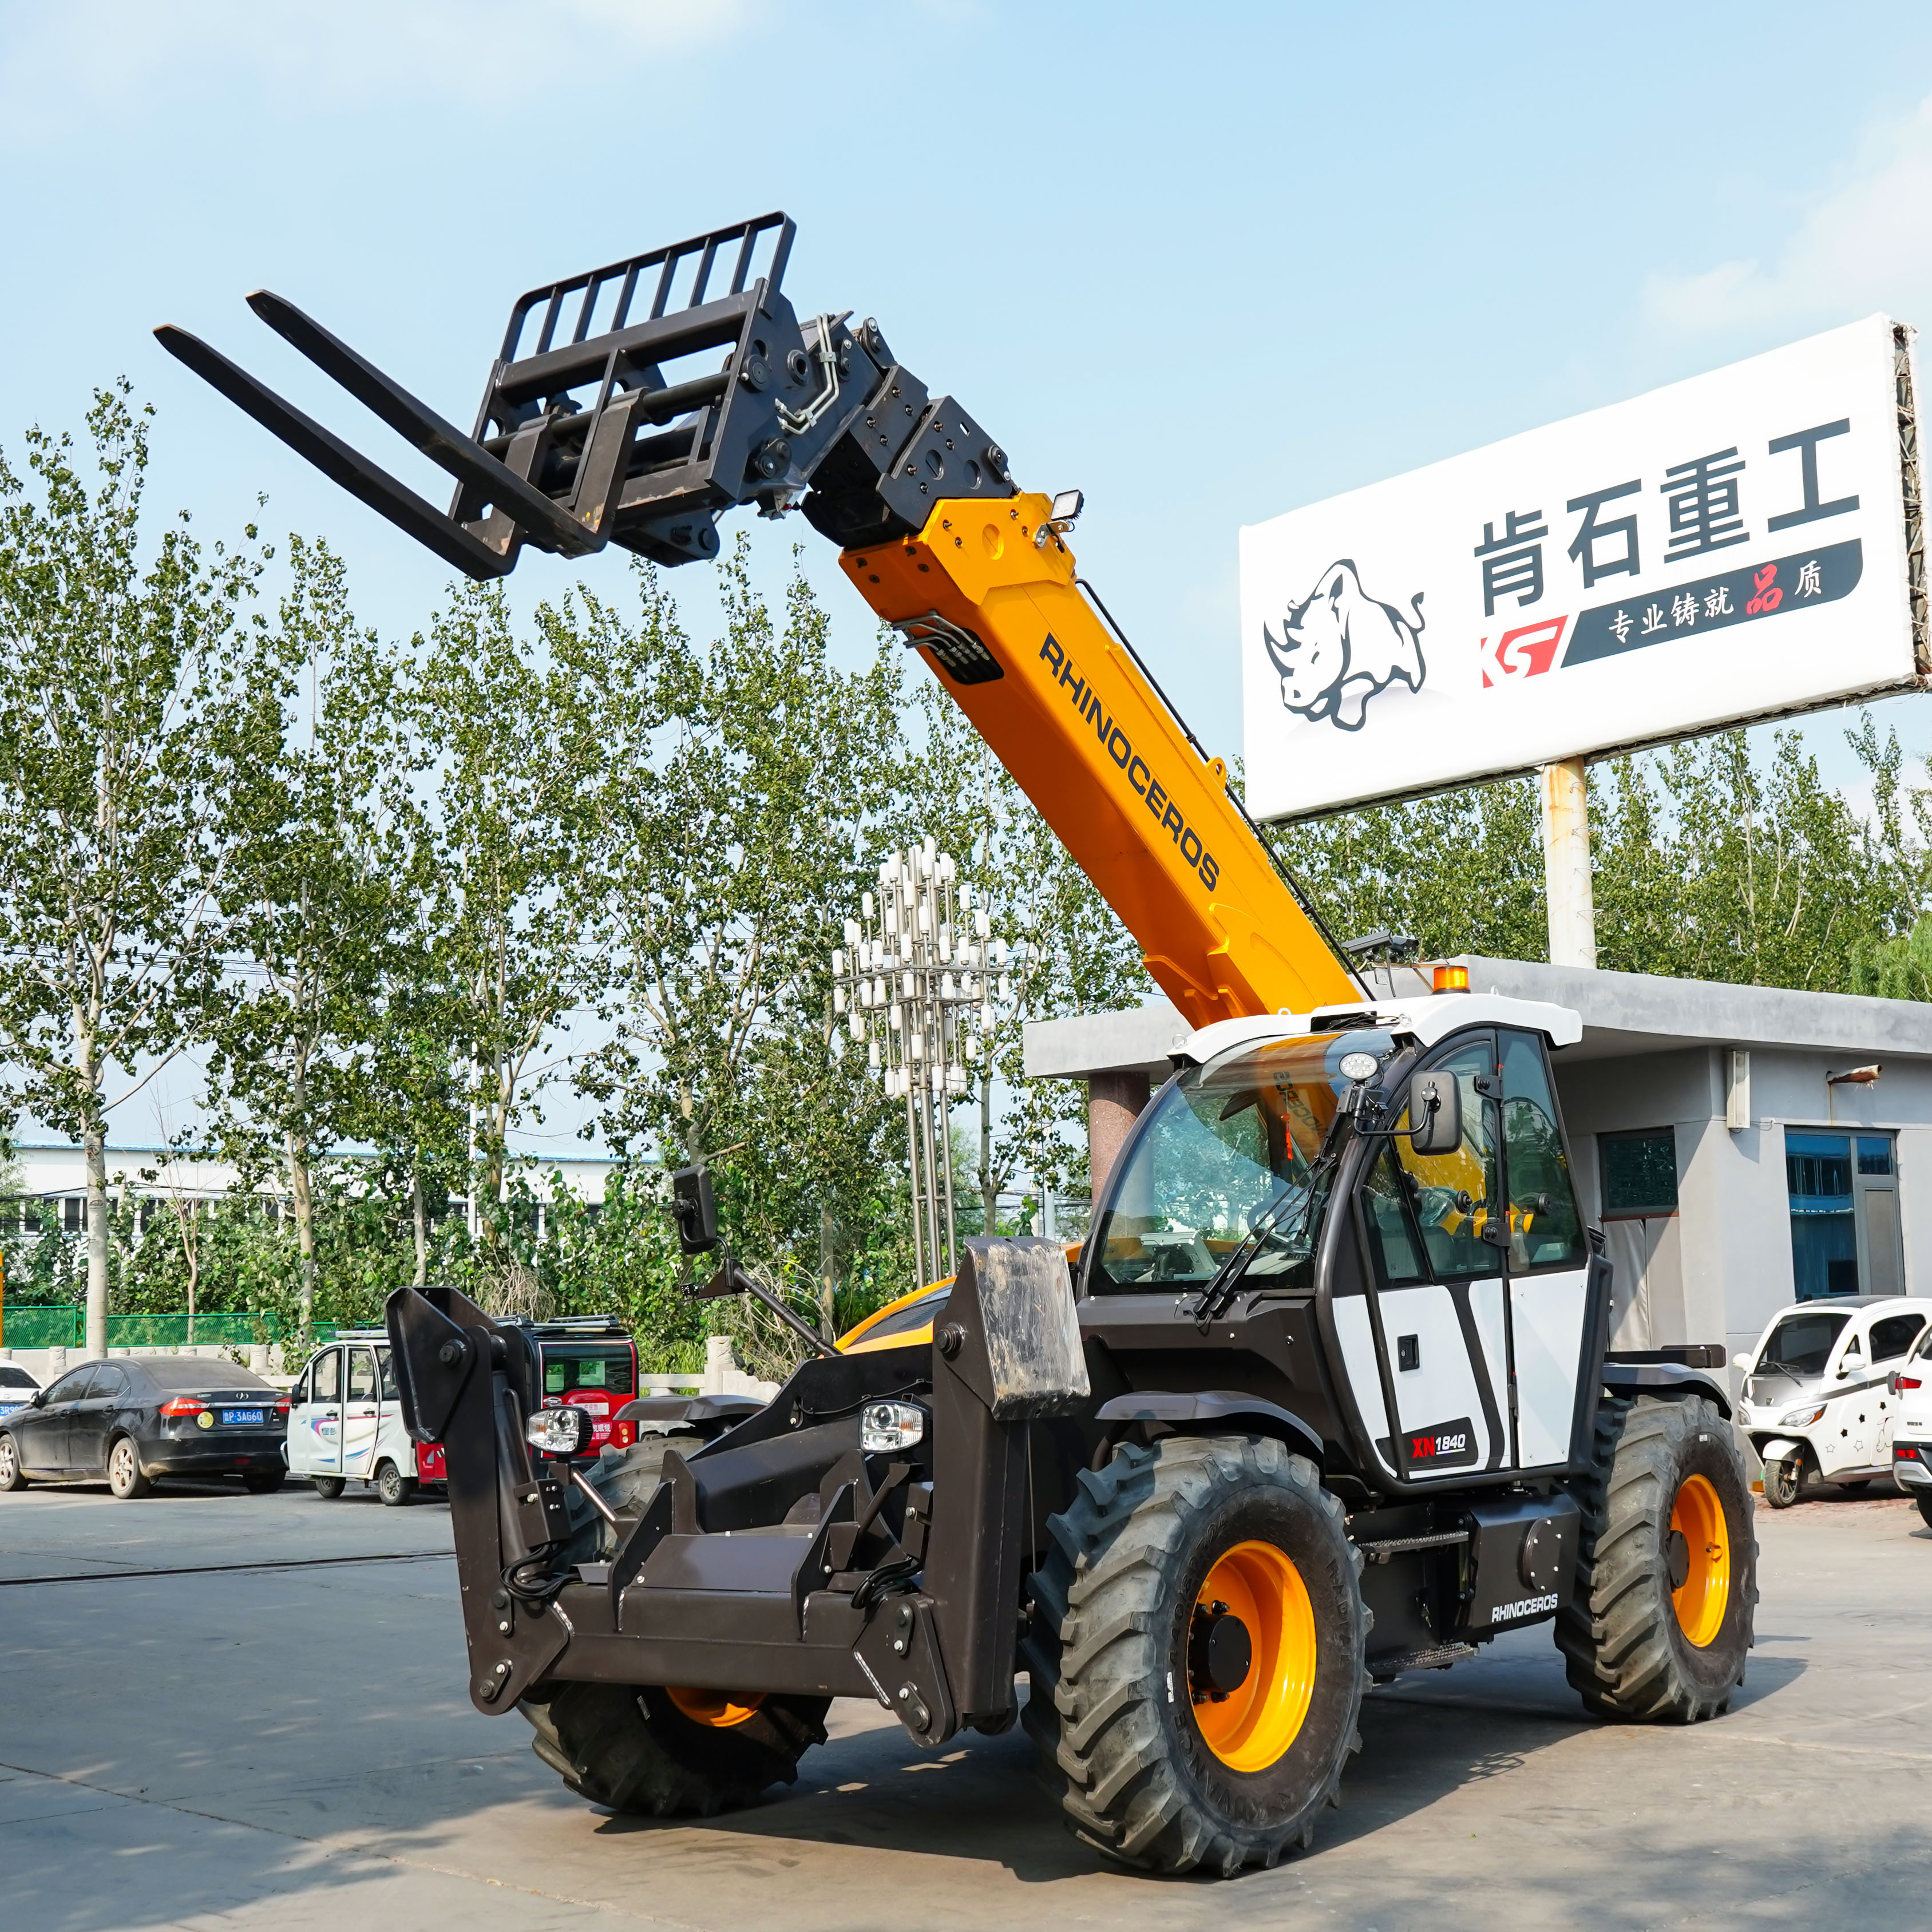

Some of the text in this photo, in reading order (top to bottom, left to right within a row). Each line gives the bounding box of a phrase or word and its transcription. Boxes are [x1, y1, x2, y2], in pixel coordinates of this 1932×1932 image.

[1474, 418, 1860, 617] 肯石重工
[1039, 632, 1220, 892] RHINOCEROS
[1411, 1434, 1466, 1458] XN1840
[1491, 1593, 1558, 1623] RHINOCEROS
